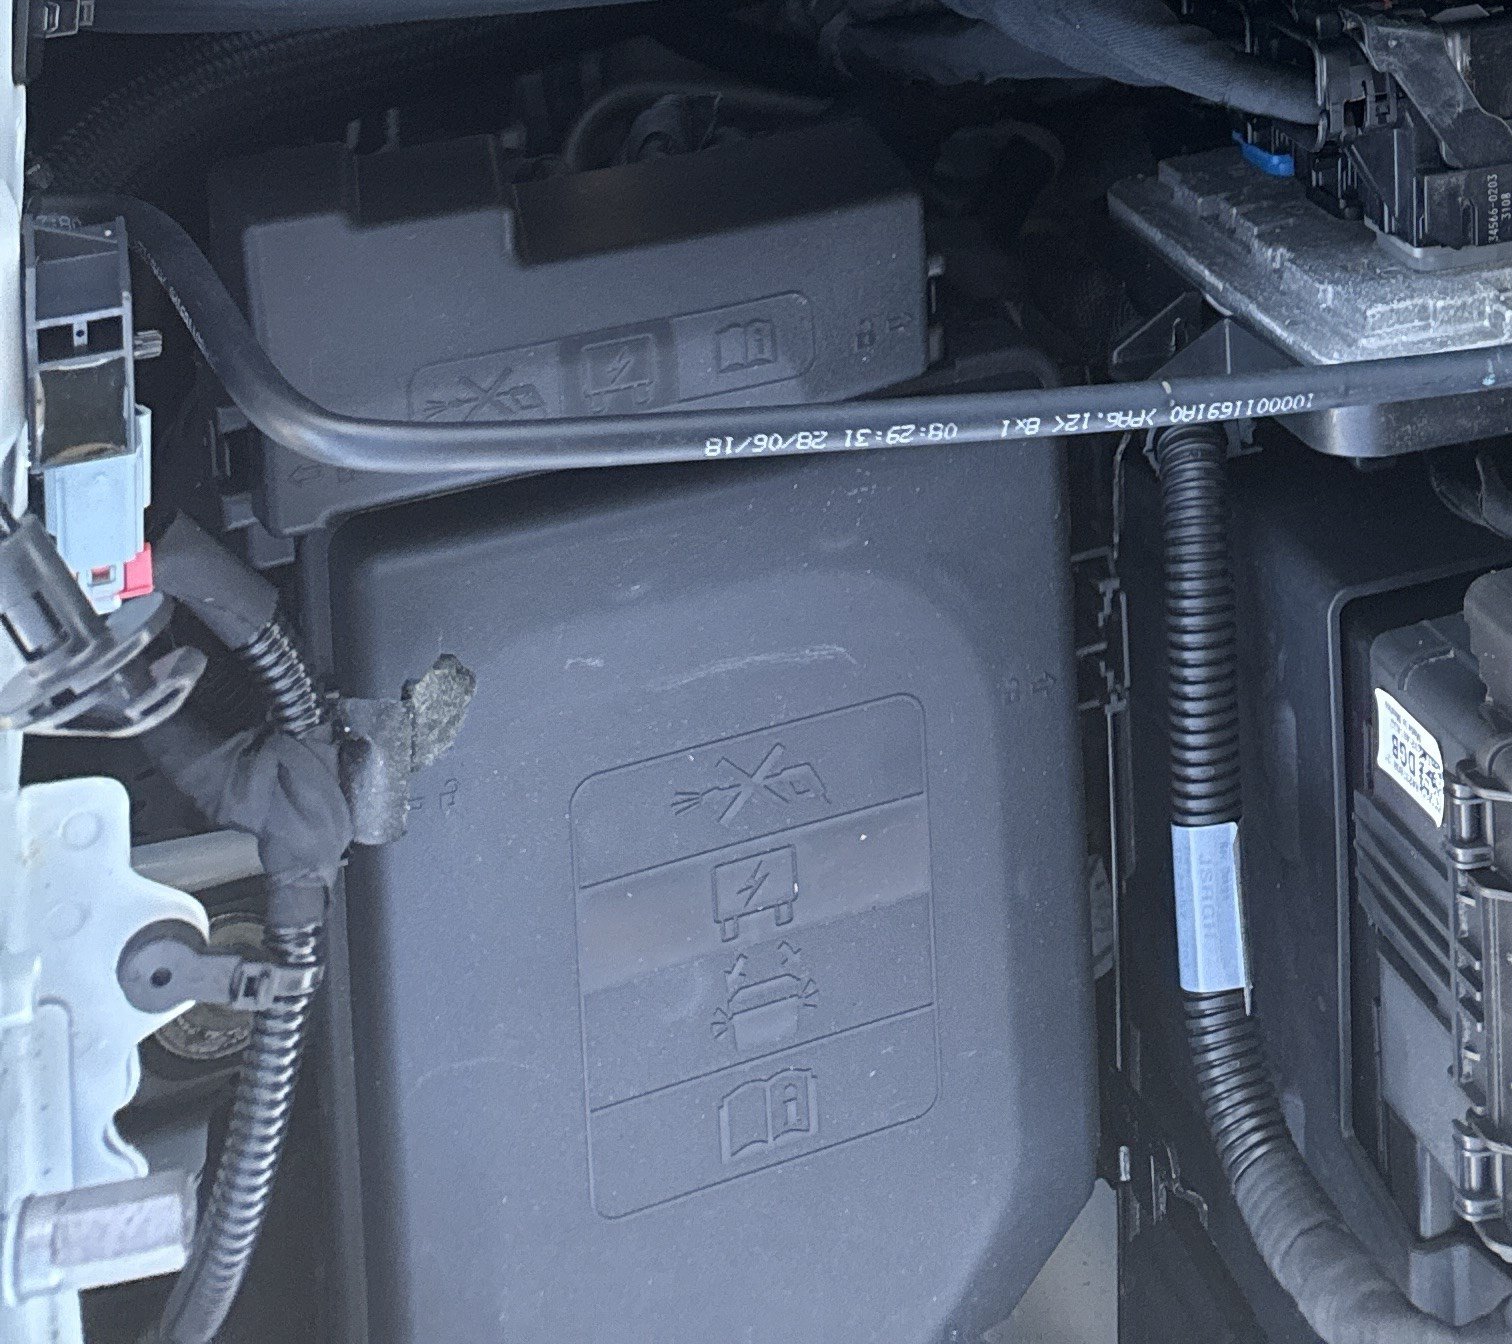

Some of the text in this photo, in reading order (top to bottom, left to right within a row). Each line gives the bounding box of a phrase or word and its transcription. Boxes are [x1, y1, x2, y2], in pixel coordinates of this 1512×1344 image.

[704, 431, 829, 458] 28/06/18
[845, 422, 958, 447] 08:29:31
[1392, 734, 1416, 777] DGB
